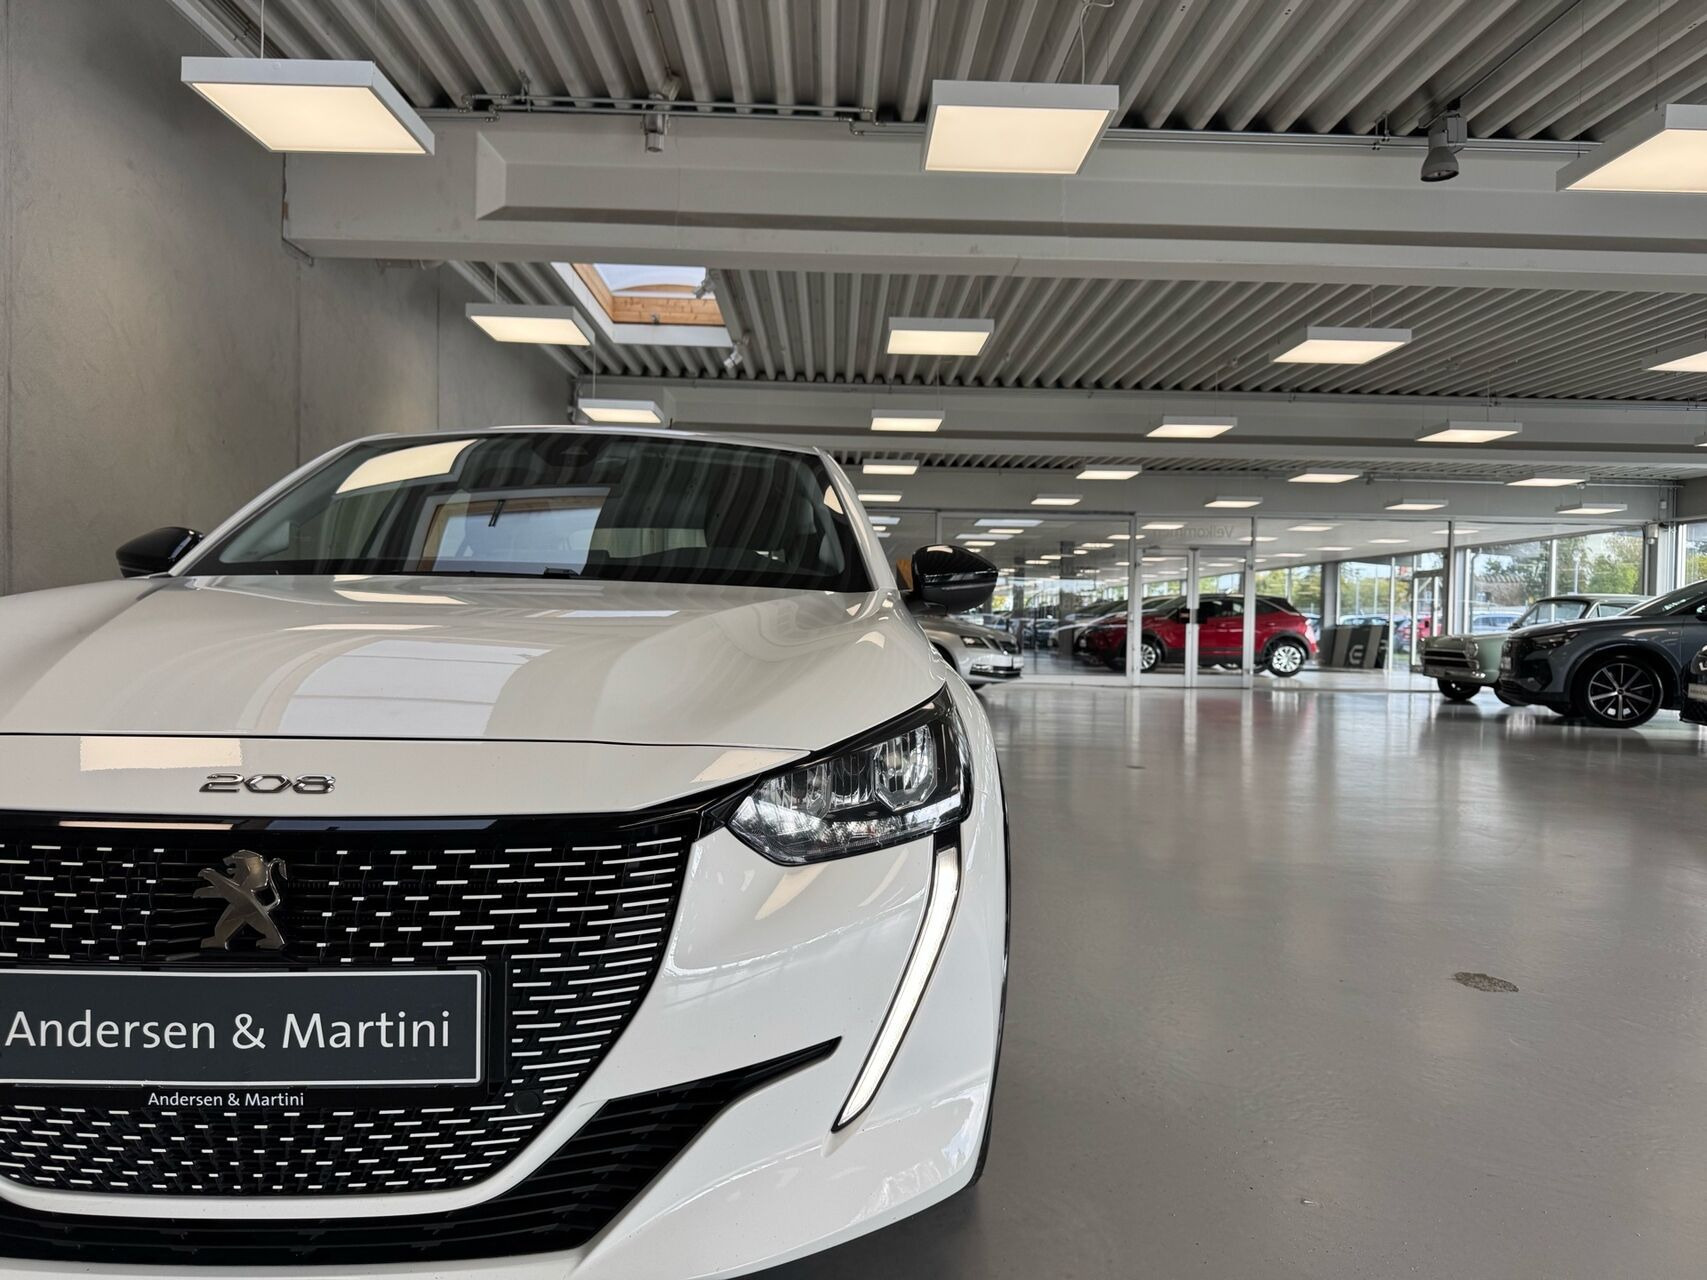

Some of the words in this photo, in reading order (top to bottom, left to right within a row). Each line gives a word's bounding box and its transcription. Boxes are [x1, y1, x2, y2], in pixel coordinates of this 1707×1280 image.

[199, 773, 336, 794] 208
[5, 1010, 215, 1048] Andersen
[232, 1013, 266, 1049] &
[283, 1011, 450, 1048] Martini
[148, 1092, 223, 1106] Andersen
[228, 1093, 241, 1106] &
[245, 1093, 304, 1106] Martini
